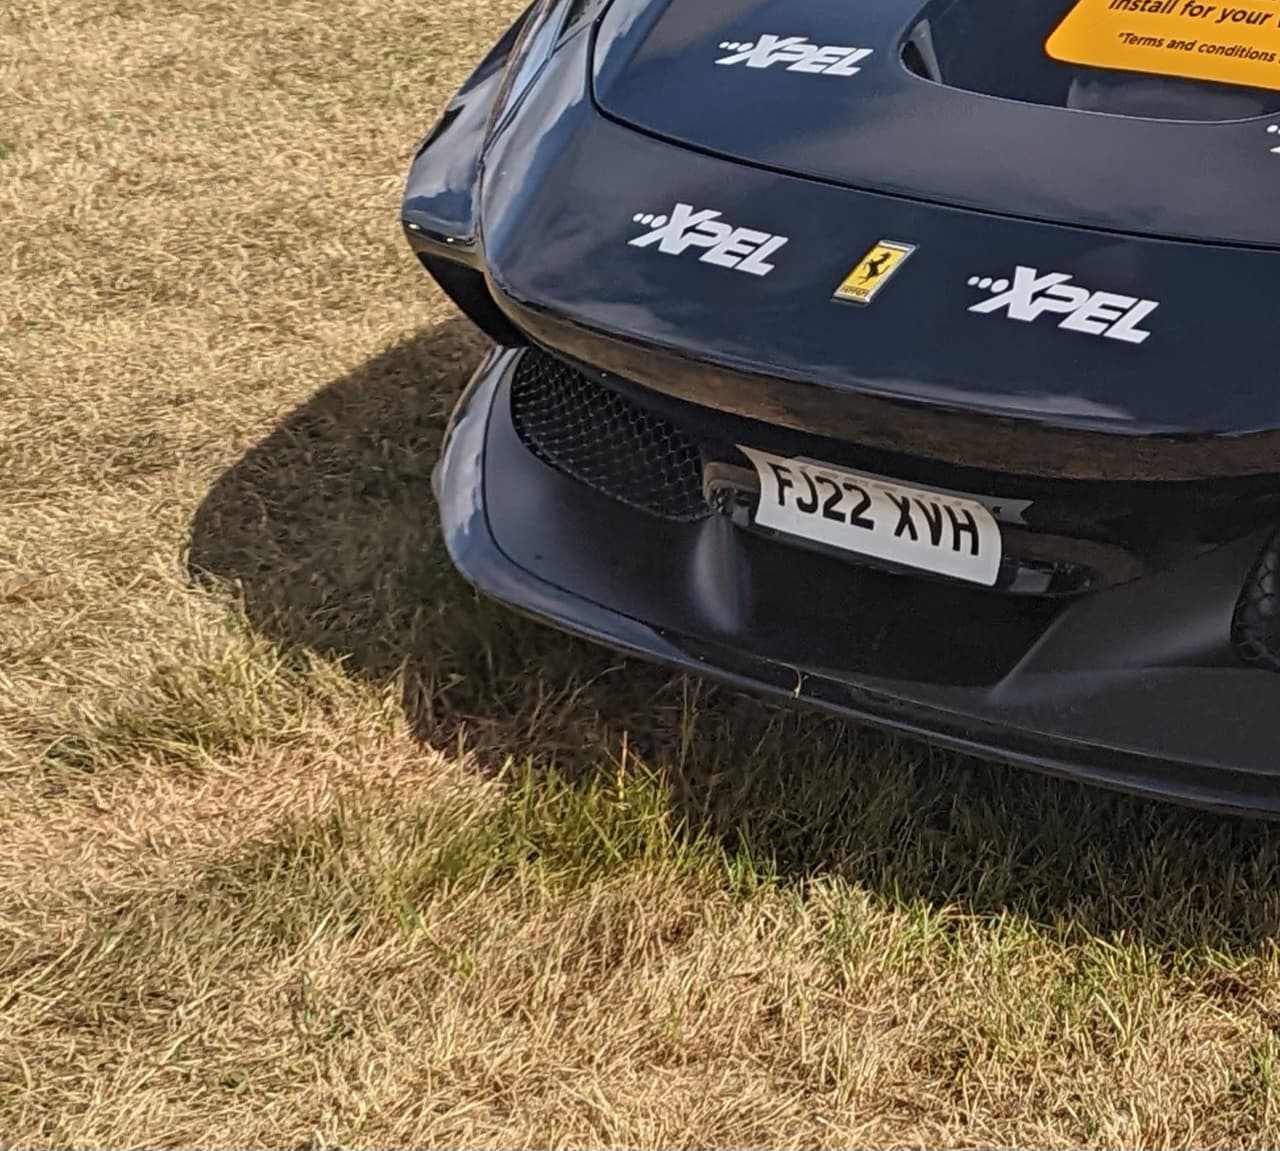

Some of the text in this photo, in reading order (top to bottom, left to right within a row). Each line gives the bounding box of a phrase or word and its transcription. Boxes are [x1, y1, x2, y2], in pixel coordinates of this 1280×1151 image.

[1179, 0, 1216, 19] for
[1215, 7, 1273, 29] your
[715, 34, 873, 77] XPEL
[1166, 36, 1197, 52] and
[1198, 41, 1277, 64] conditions
[628, 203, 789, 276] XPEL
[967, 265, 1160, 344] XPEL
[767, 461, 980, 556] FJ22 XVH
